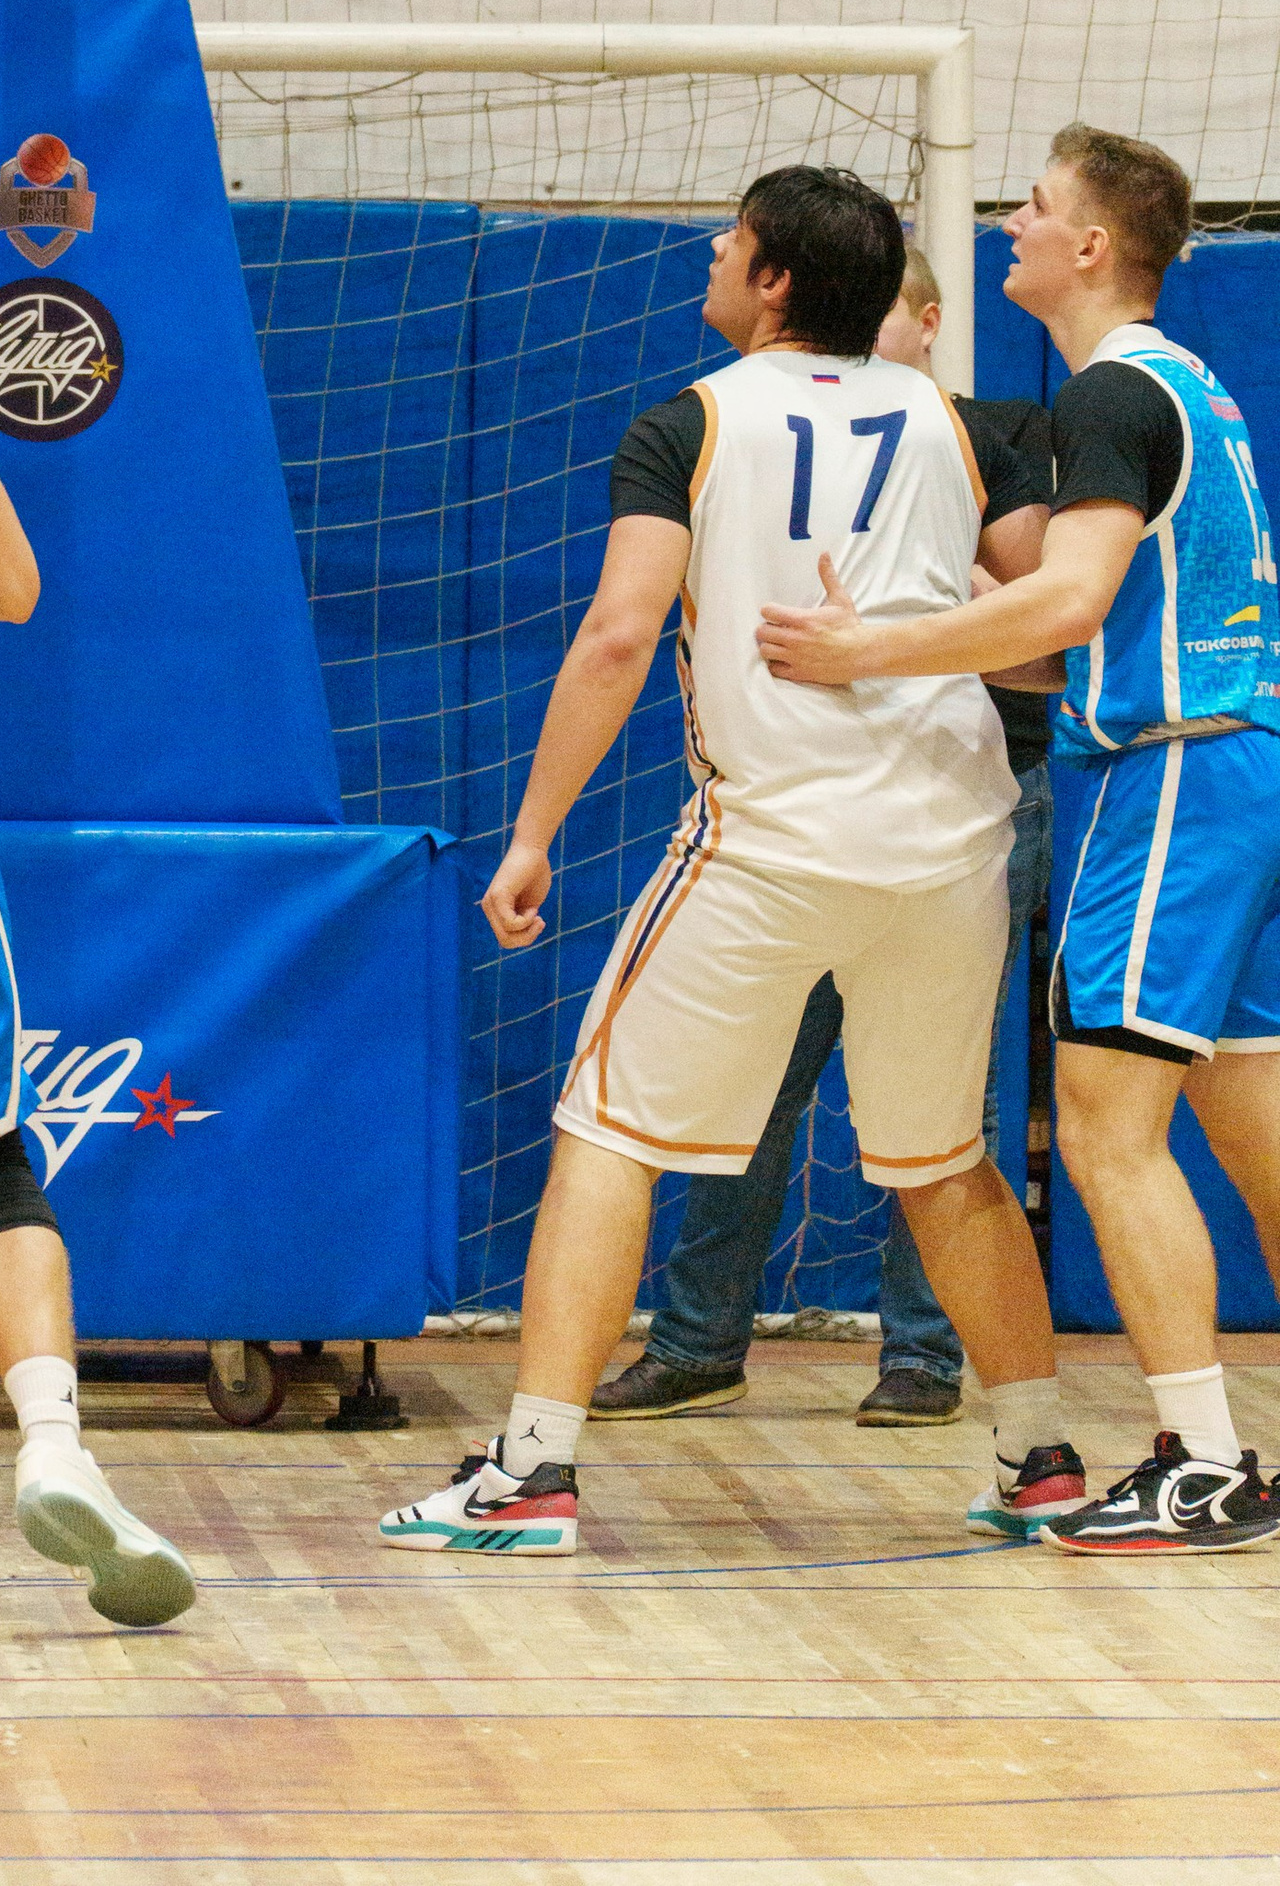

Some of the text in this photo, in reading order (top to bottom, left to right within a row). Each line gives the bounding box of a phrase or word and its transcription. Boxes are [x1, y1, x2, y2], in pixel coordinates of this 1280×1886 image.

[19, 190, 69, 206] GHETTO
[18, 207, 68, 224] BASKET
[786, 409, 907, 541] 17
